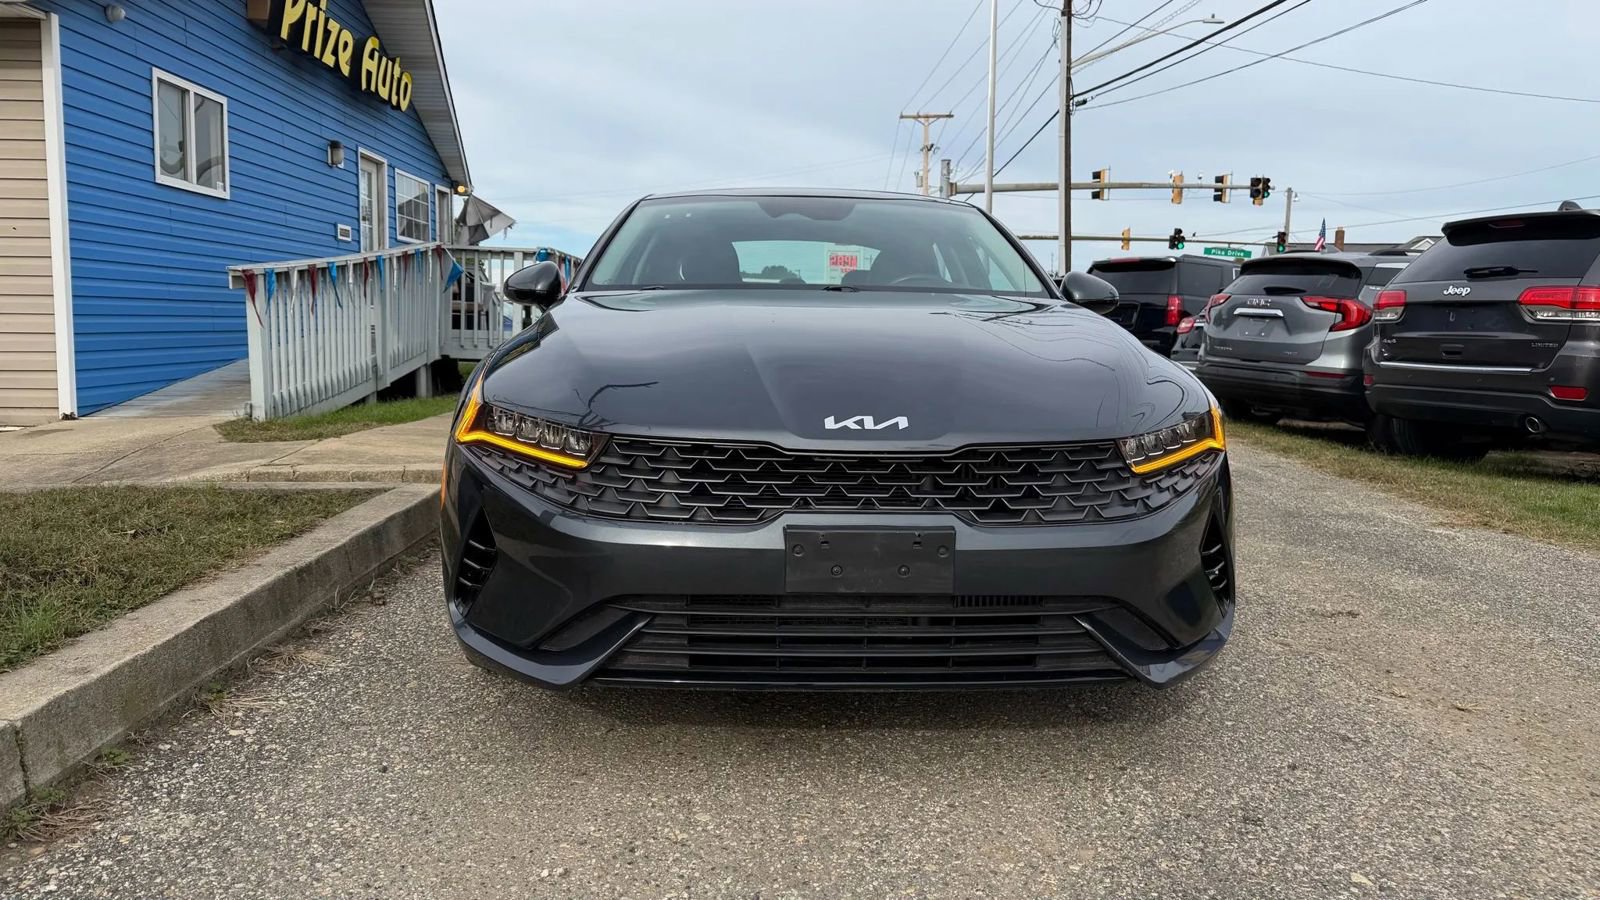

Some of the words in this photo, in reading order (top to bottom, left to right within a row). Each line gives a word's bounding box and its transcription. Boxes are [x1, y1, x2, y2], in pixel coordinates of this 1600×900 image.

[280, 0, 354, 78] Prize
[361, 36, 413, 112] Auto
[1227, 249, 1245, 258] Drive
[1443, 285, 1471, 297] Jeep
[824, 415, 909, 430] KIA
